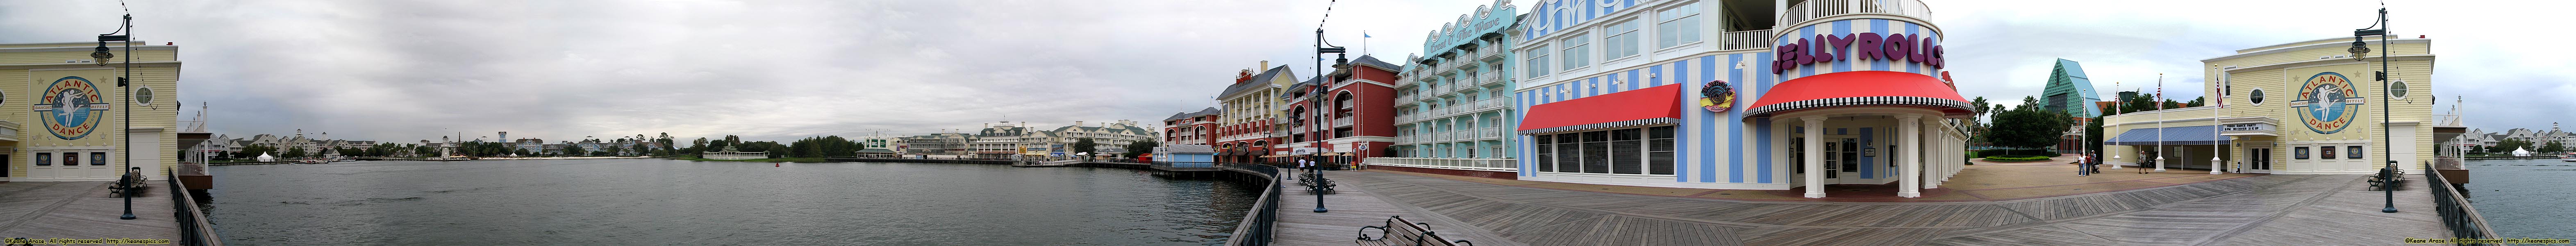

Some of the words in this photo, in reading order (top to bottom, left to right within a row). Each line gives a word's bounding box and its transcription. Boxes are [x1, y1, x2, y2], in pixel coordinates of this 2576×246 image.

[1430, 39, 1446, 53] Crest
[1448, 34, 1455, 45] O'
[1457, 29, 1472, 42] The
[1474, 18, 1500, 34] Wave
[1772, 32, 1944, 75] JELLYROLLS
[45, 80, 98, 103] ATLANTIC
[1701, 80, 1732, 96] JELLYROLLS
[2302, 75, 2353, 99] ATLANTIC
[52, 123, 89, 135] DANCE
[2310, 117, 2346, 130] DANCE
